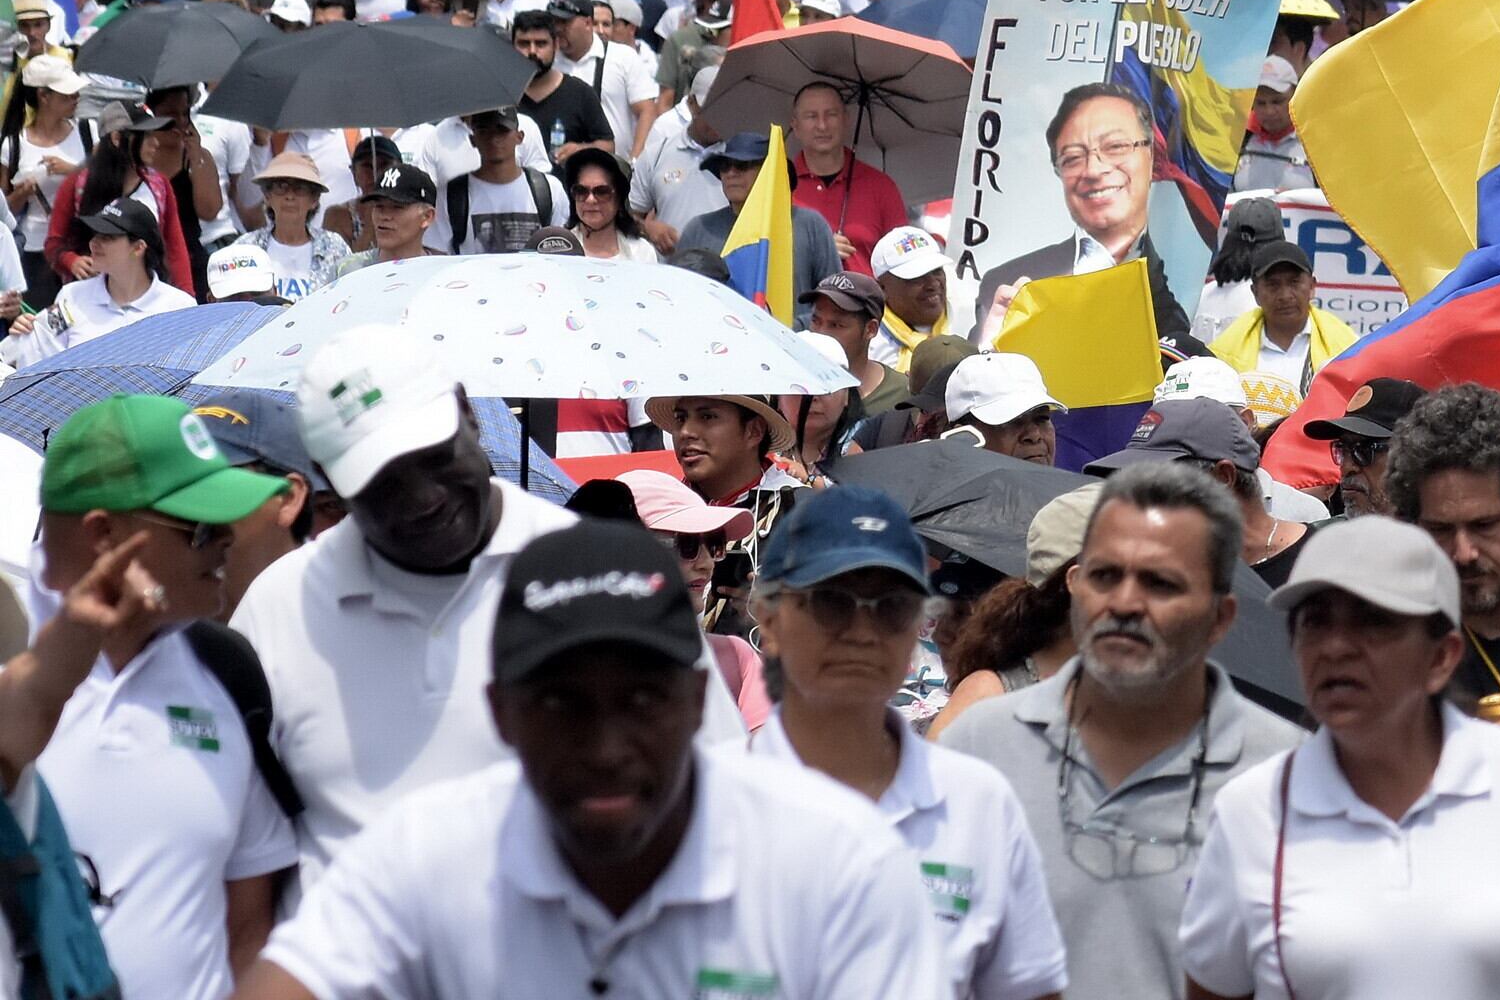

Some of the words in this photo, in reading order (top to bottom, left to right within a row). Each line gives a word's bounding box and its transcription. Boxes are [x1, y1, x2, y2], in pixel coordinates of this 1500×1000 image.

[1046, 19, 1105, 63] DEL
[1113, 19, 1203, 73] PUEBLO
[1309, 294, 1403, 312] acion
